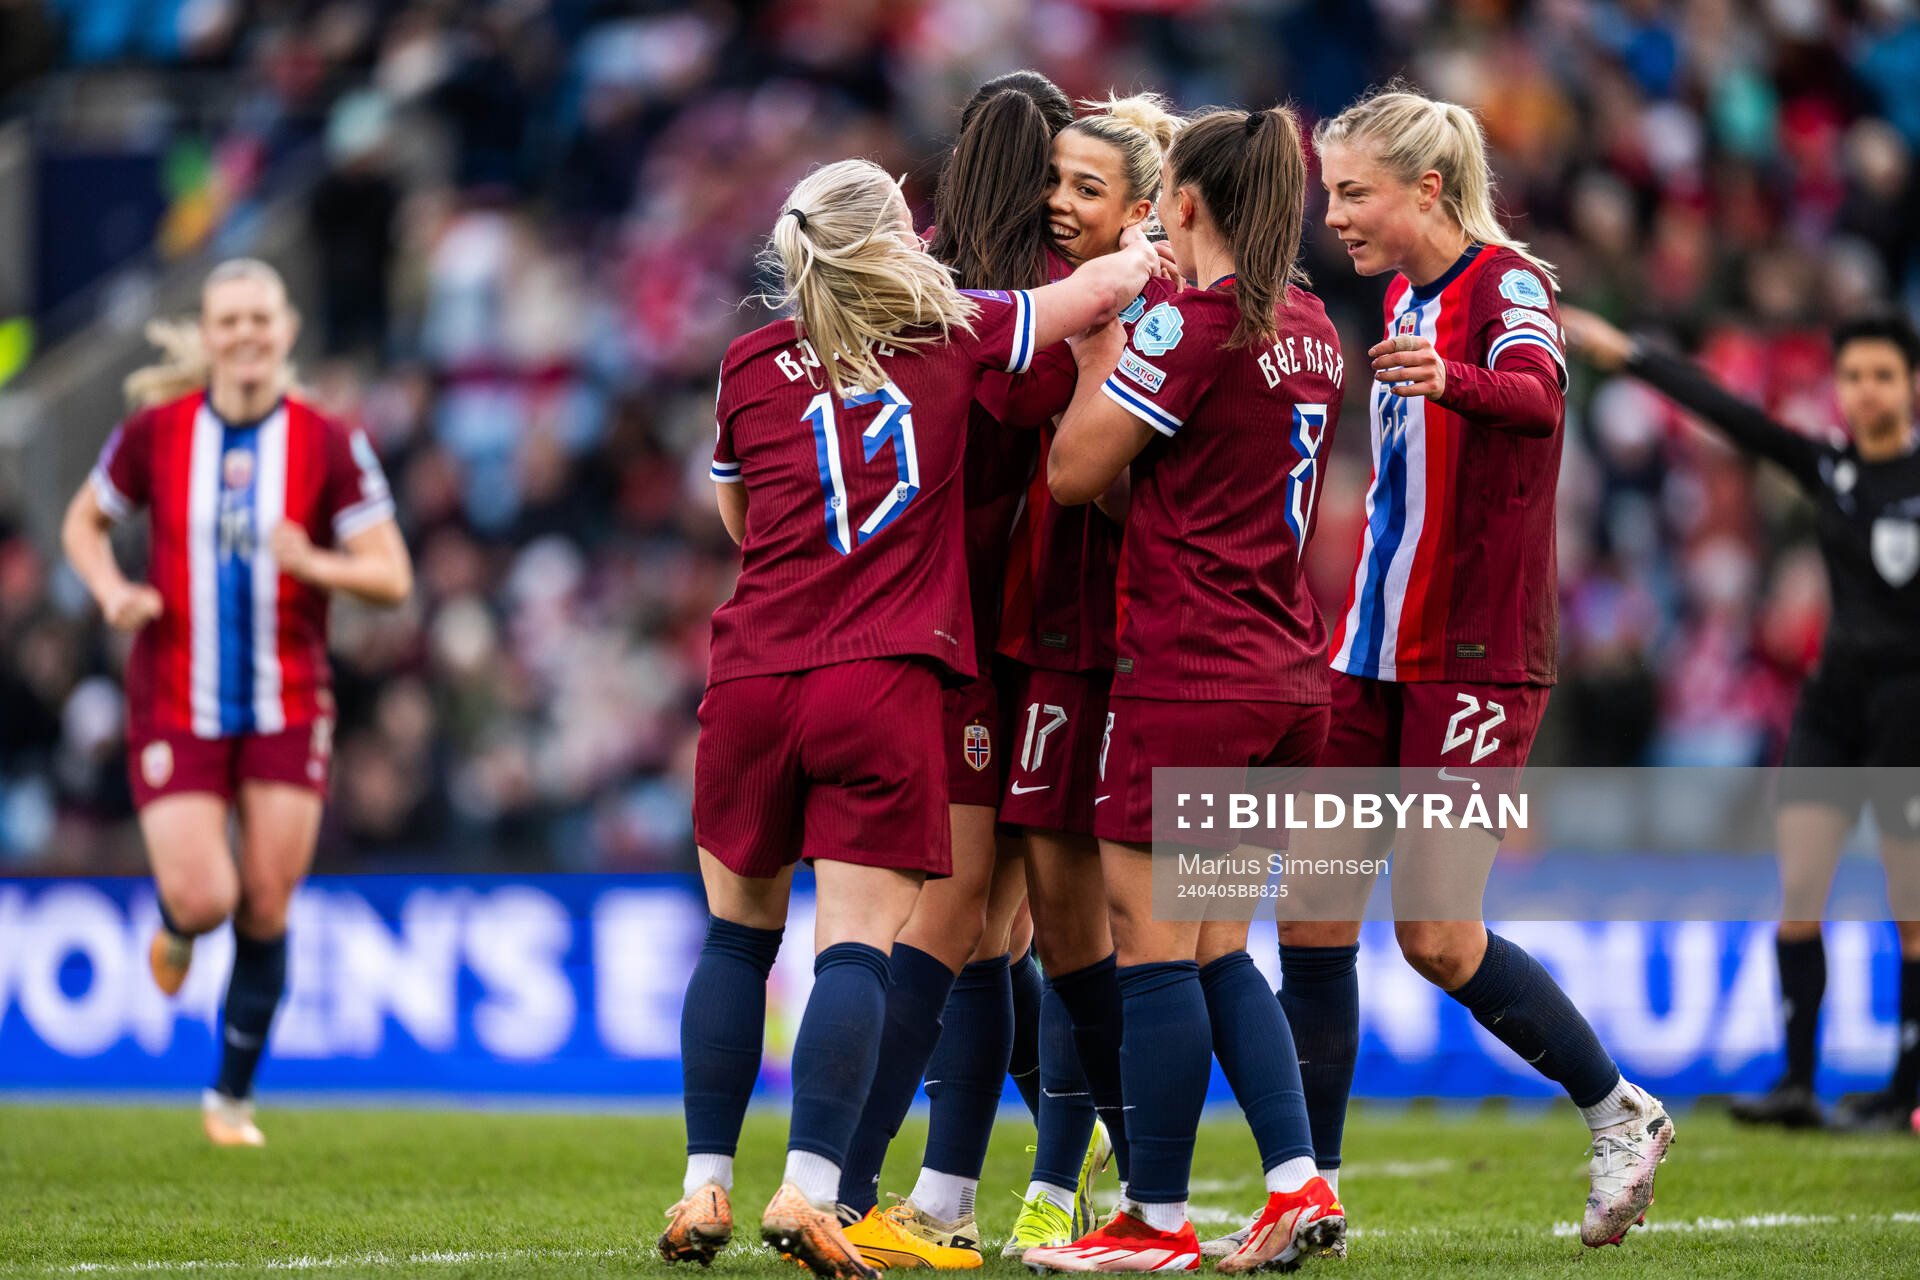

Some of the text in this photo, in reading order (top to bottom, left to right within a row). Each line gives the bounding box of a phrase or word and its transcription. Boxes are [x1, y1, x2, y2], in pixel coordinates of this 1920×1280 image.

[800, 380, 920, 556] 13
[1284, 403, 1327, 563] 8
[1020, 703, 1068, 773] 17
[1440, 692, 1506, 765] 22
